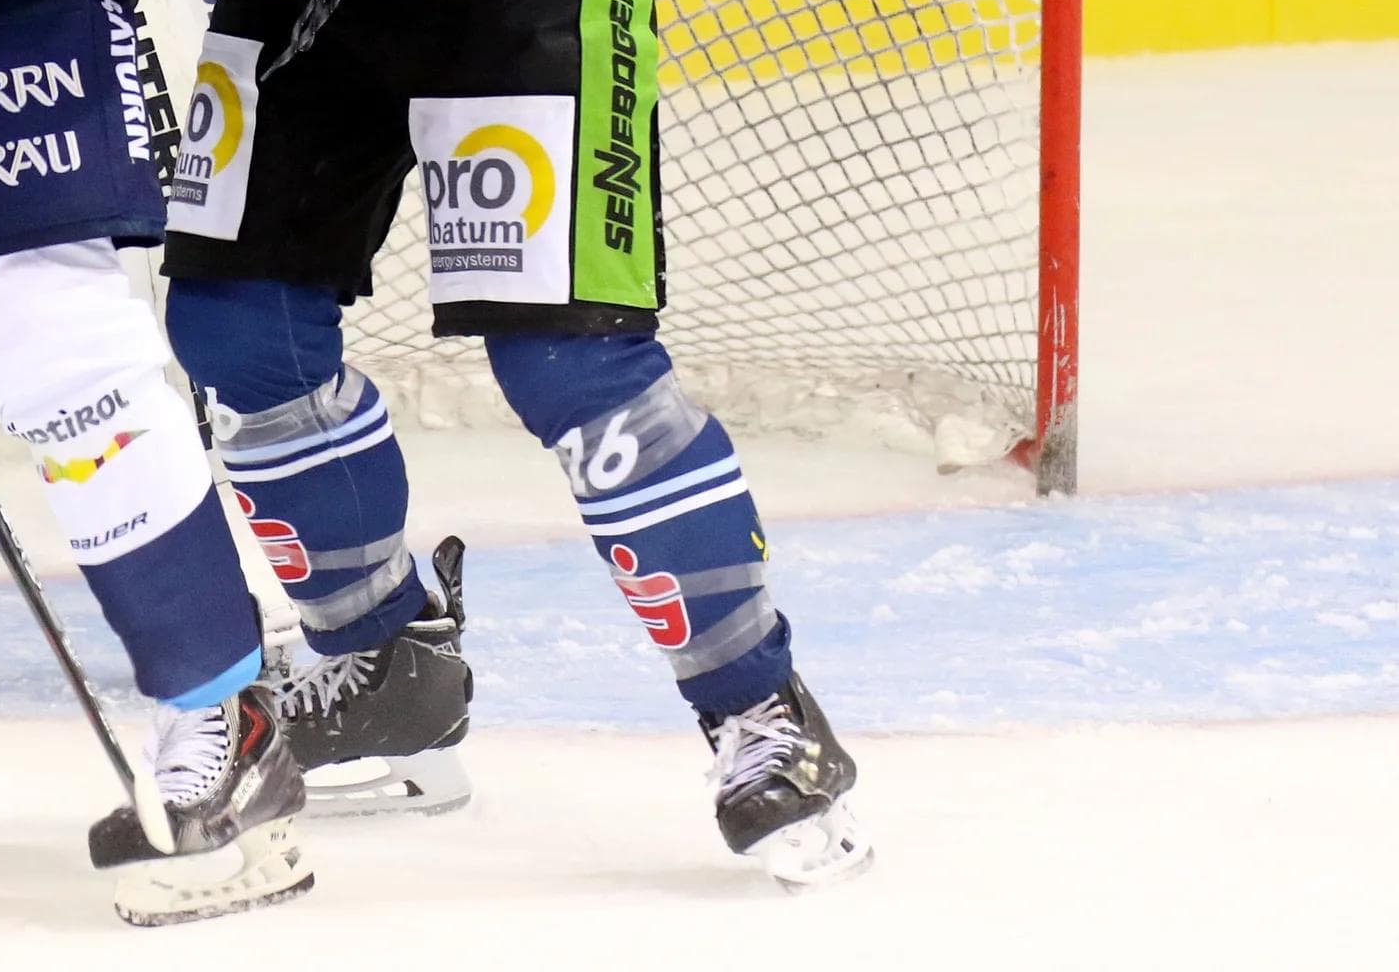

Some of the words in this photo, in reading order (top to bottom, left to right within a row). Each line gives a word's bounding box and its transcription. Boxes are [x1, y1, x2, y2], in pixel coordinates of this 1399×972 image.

[422, 157, 516, 211] pro
[428, 210, 524, 245] batum
[558, 412, 640, 495] 16
[69, 511, 149, 551] BAUER
